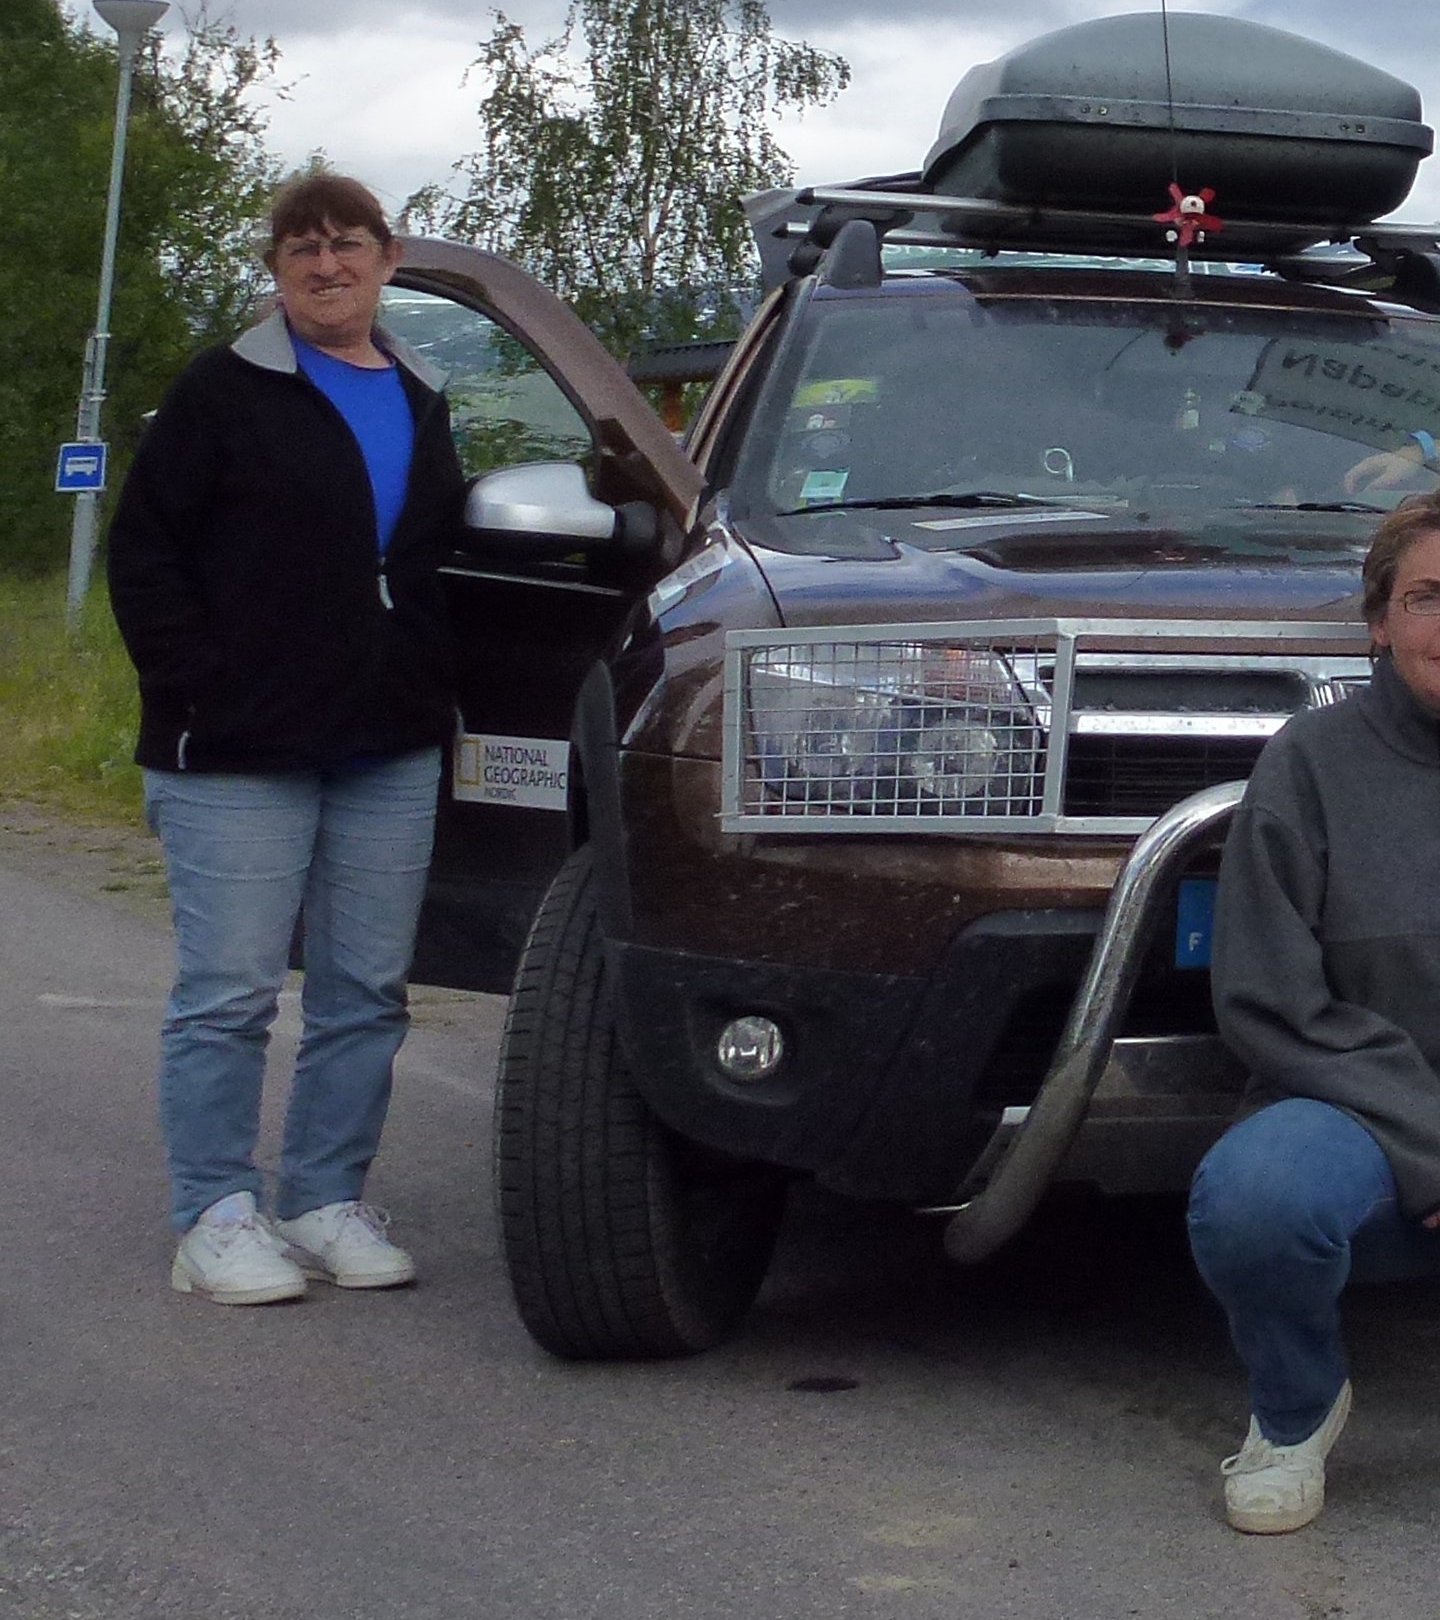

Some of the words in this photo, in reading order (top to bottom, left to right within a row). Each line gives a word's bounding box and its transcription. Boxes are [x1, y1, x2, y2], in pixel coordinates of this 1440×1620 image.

[485, 745, 549, 767] NATIONAL
[484, 766, 566, 790] GEOGRAPHIC
[1189, 932, 1203, 951] F
